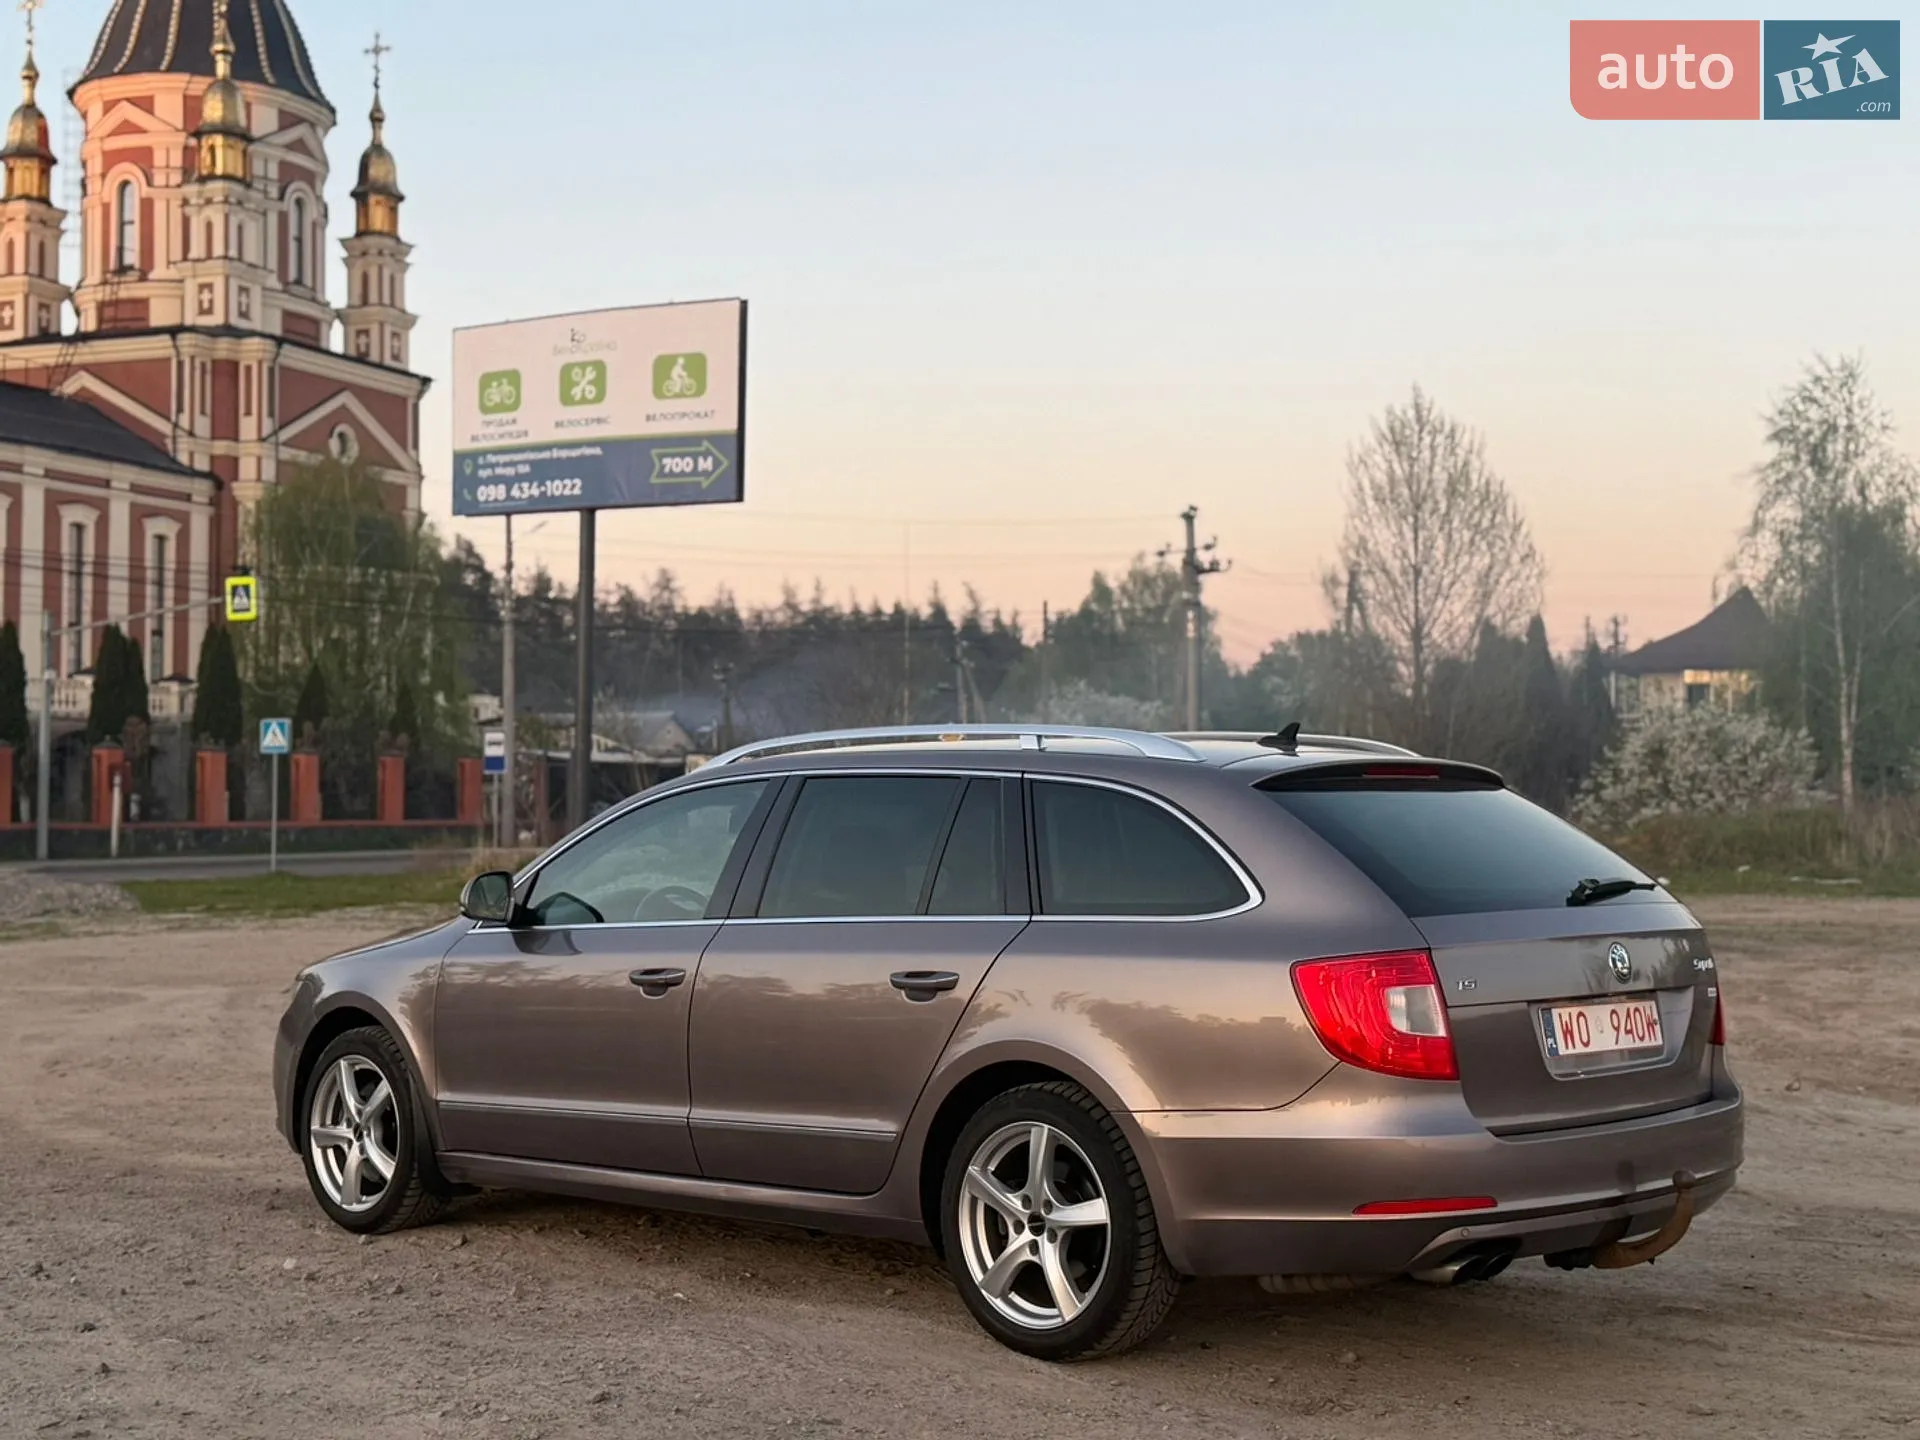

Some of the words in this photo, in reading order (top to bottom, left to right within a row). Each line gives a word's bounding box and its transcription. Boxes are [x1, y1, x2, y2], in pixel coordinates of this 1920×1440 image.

[661, 456, 694, 473] 700
[476, 484, 507, 502] 098
[510, 478, 582, 499] 434-1022
